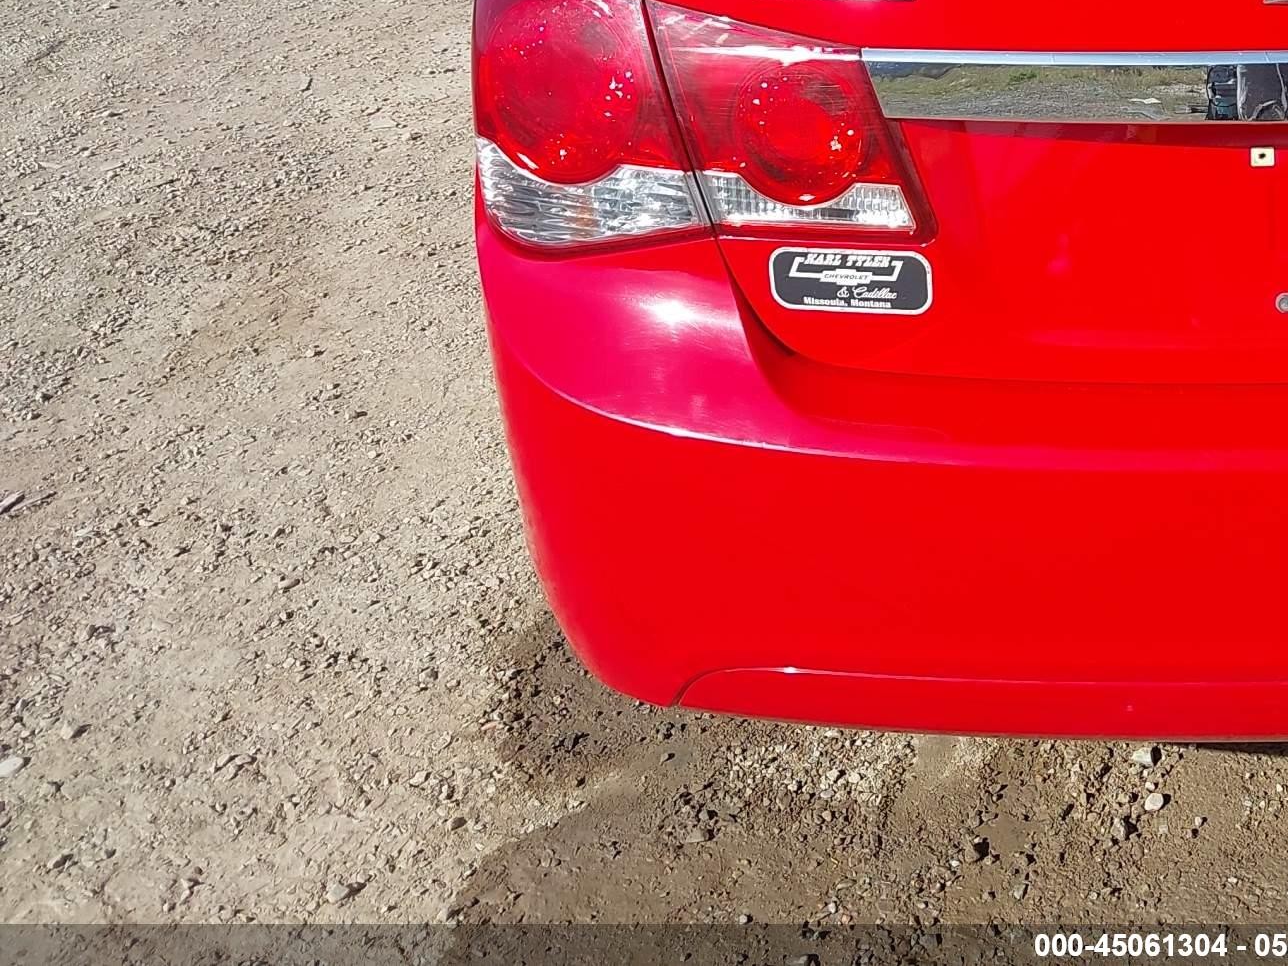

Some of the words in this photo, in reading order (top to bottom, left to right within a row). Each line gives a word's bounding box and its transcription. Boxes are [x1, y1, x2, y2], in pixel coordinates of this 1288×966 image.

[803, 253, 842, 266] KARL
[823, 273, 868, 281] CHEVROLET
[836, 286, 850, 298] &
[852, 286, 898, 300] Cadillac
[850, 298, 892, 309] Montana
